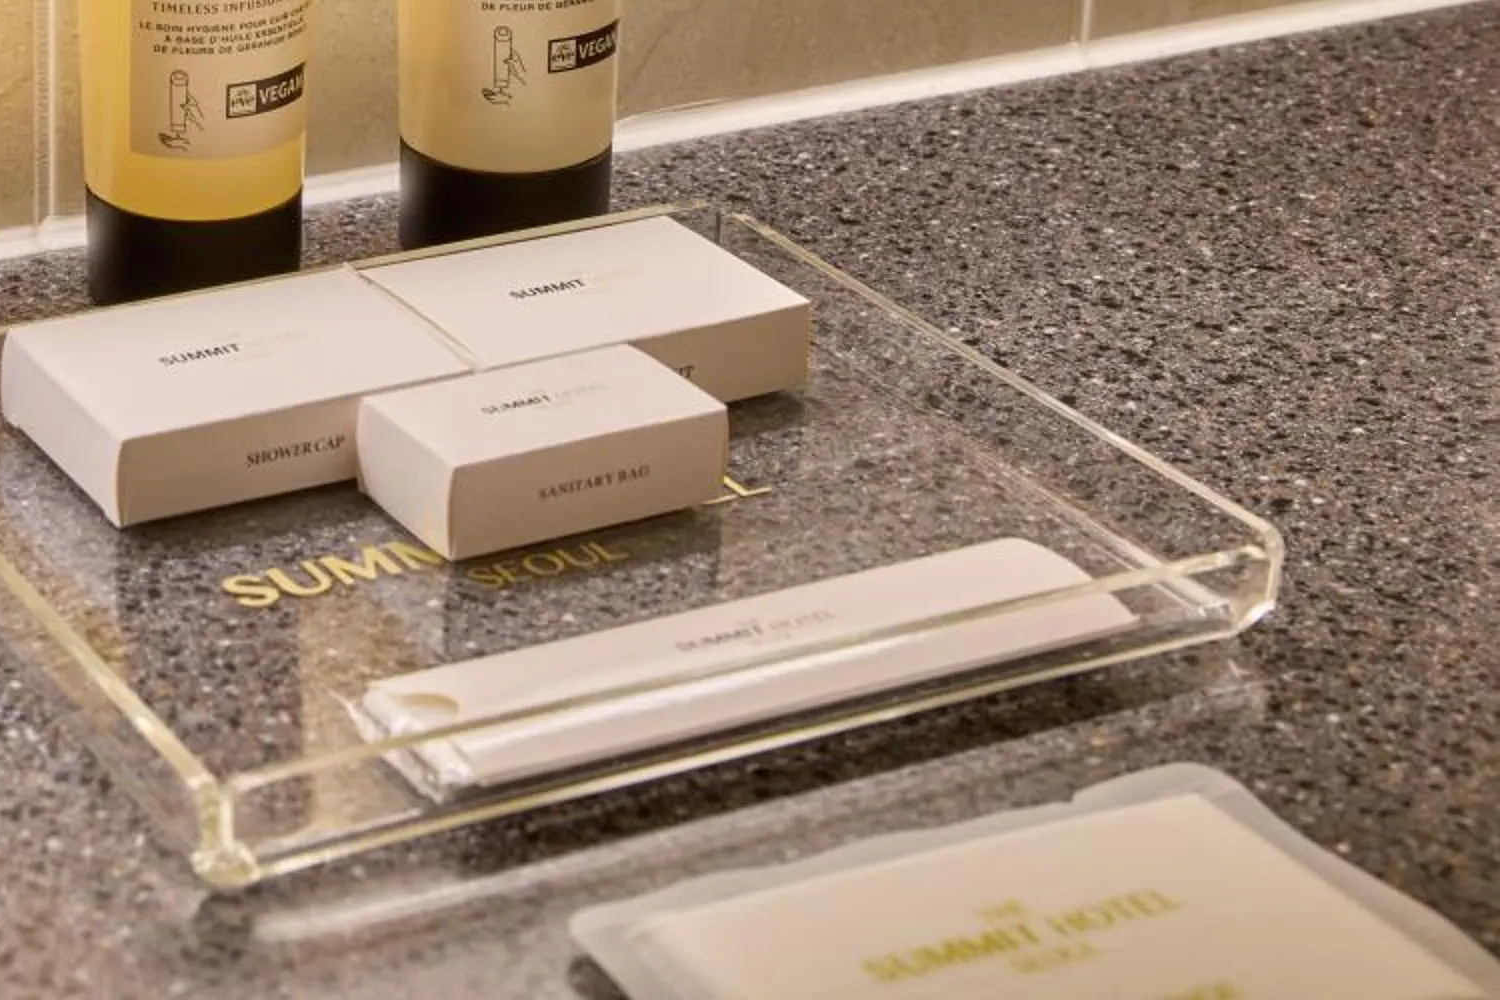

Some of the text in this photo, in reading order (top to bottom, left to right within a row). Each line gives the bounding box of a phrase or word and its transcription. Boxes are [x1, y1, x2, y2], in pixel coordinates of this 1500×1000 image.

[152, 1, 220, 15] TIMELESS
[509, 278, 585, 299] SUMMIT
[158, 343, 240, 367] SUMMIT
[246, 434, 346, 468] SHOWER CAP
[537, 463, 650, 499] SANITARY BAG
[467, 541, 630, 590] SEOUL
